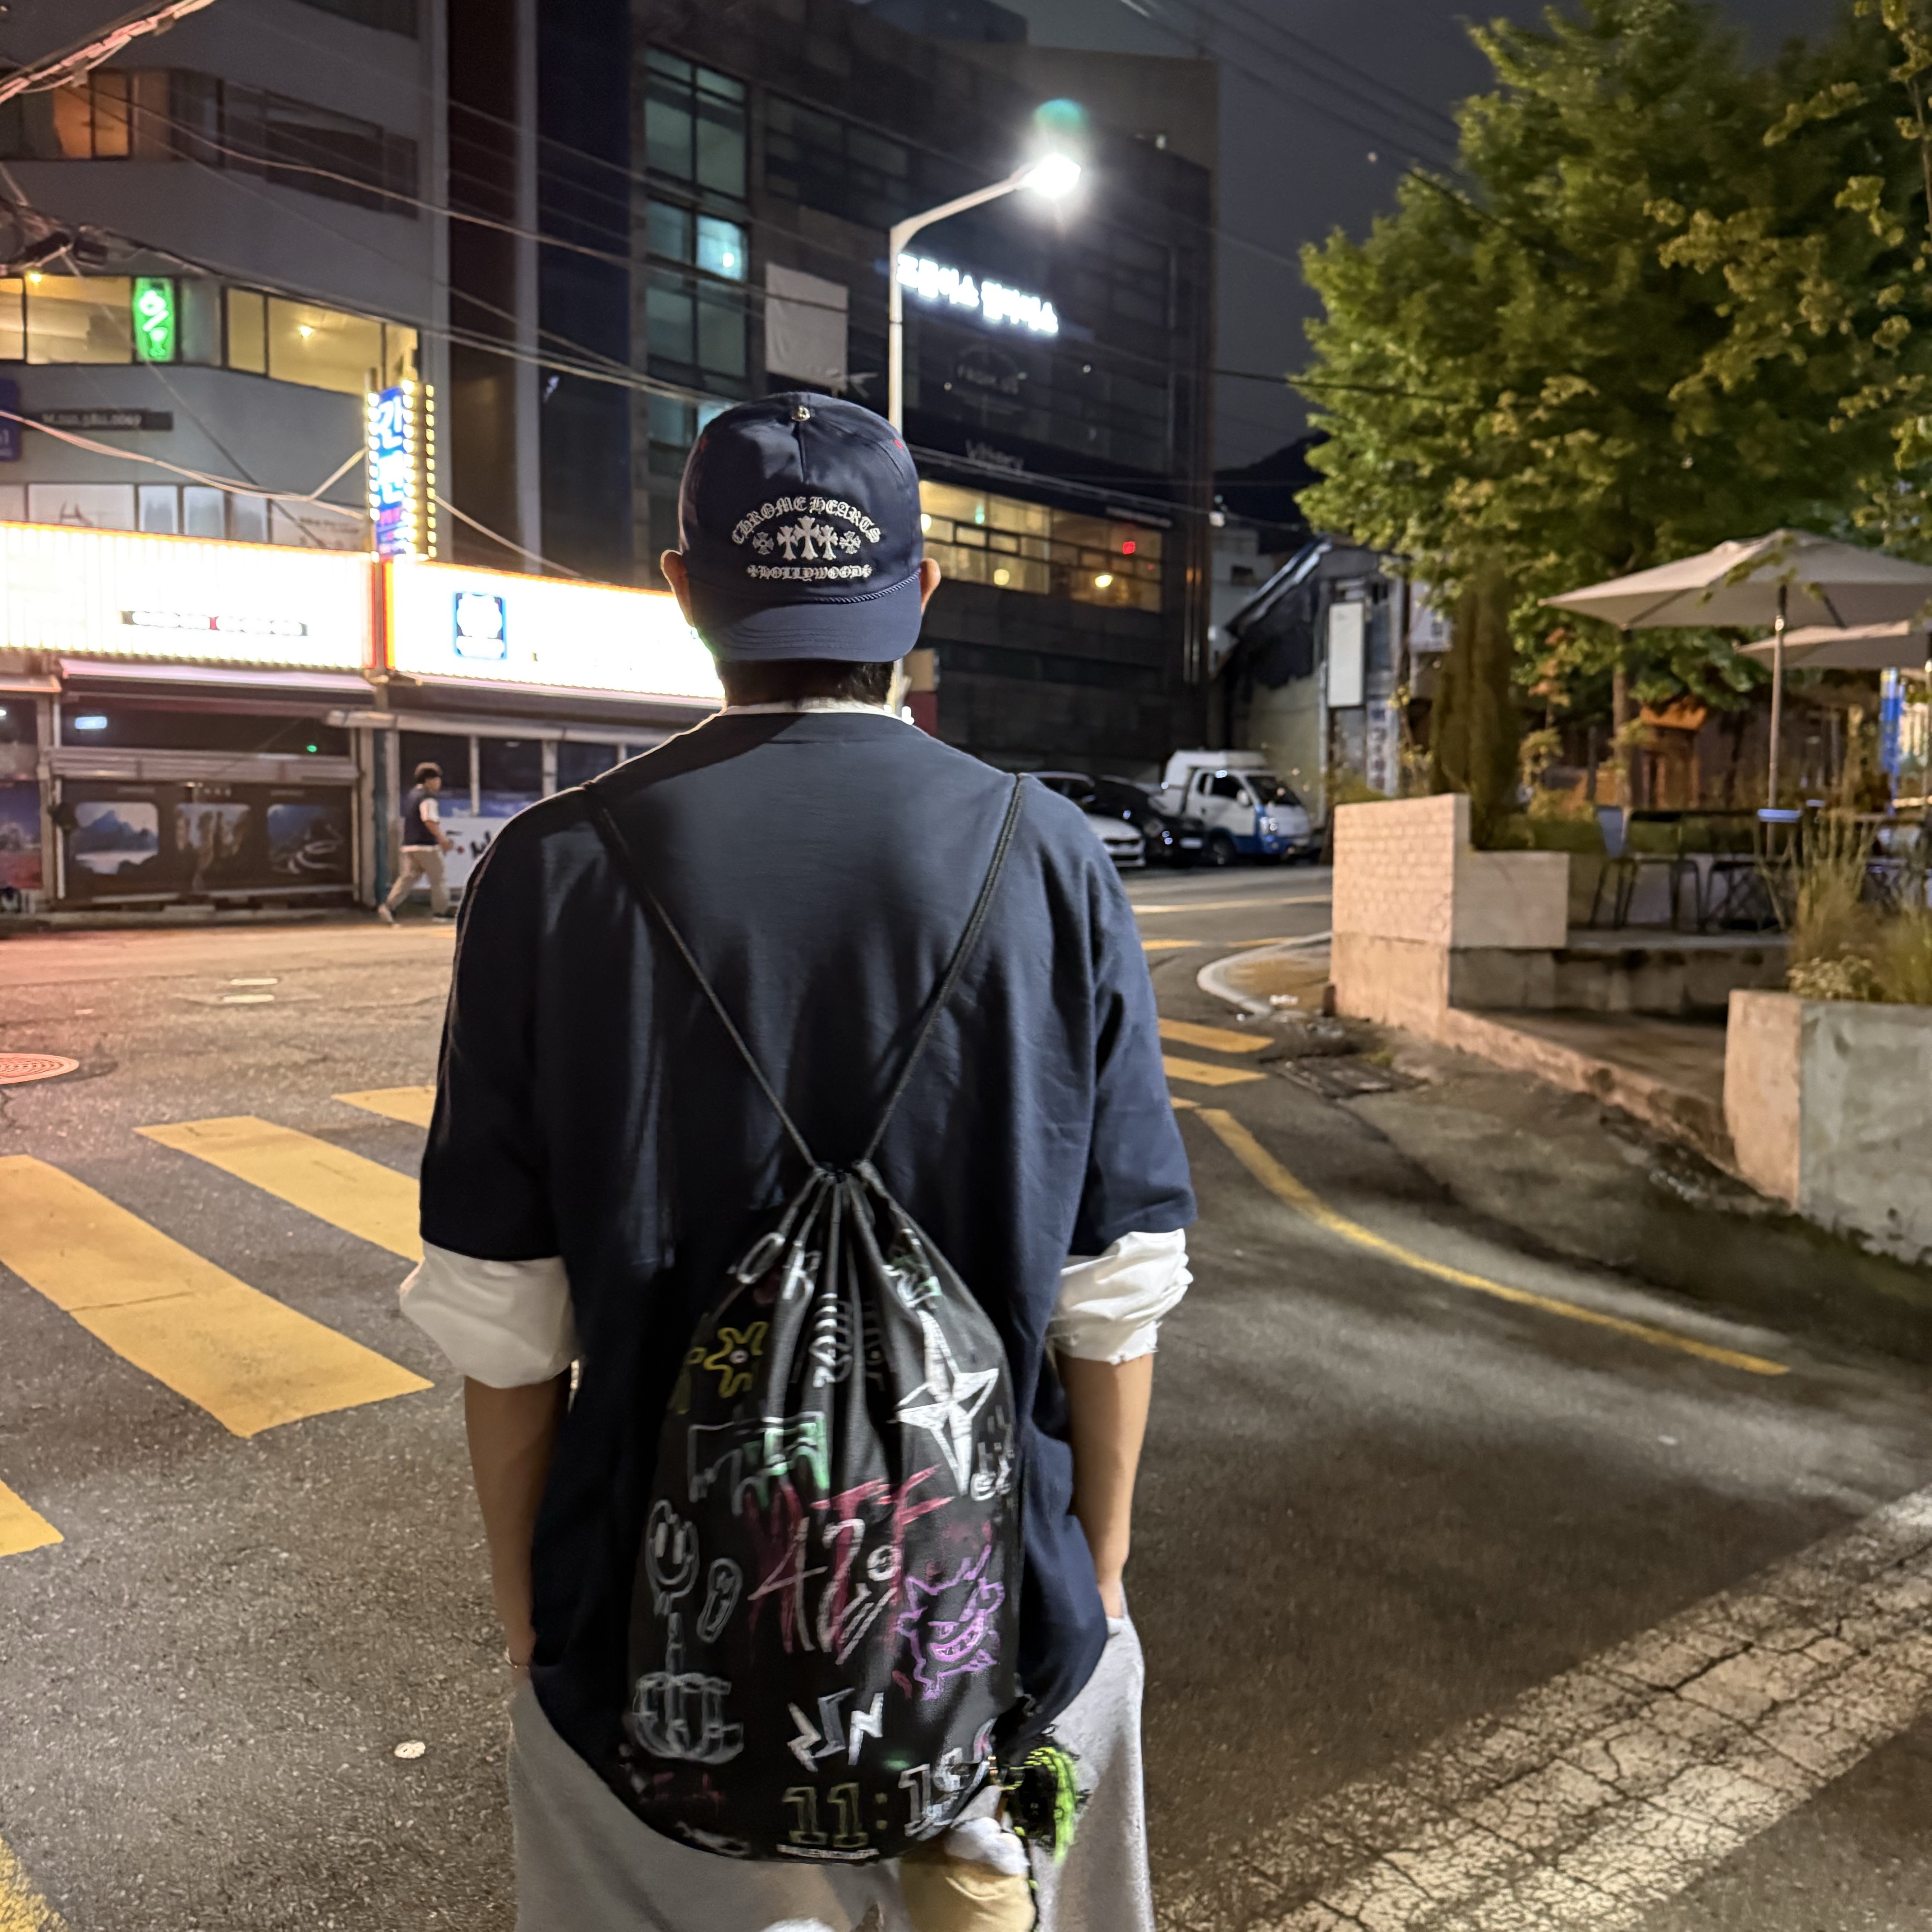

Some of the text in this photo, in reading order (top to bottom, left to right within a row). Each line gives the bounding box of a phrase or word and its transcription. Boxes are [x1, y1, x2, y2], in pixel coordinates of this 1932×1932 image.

[731, 496, 882, 545] CHROME HEARTS
[758, 565, 863, 581] HOLLYWOOD
